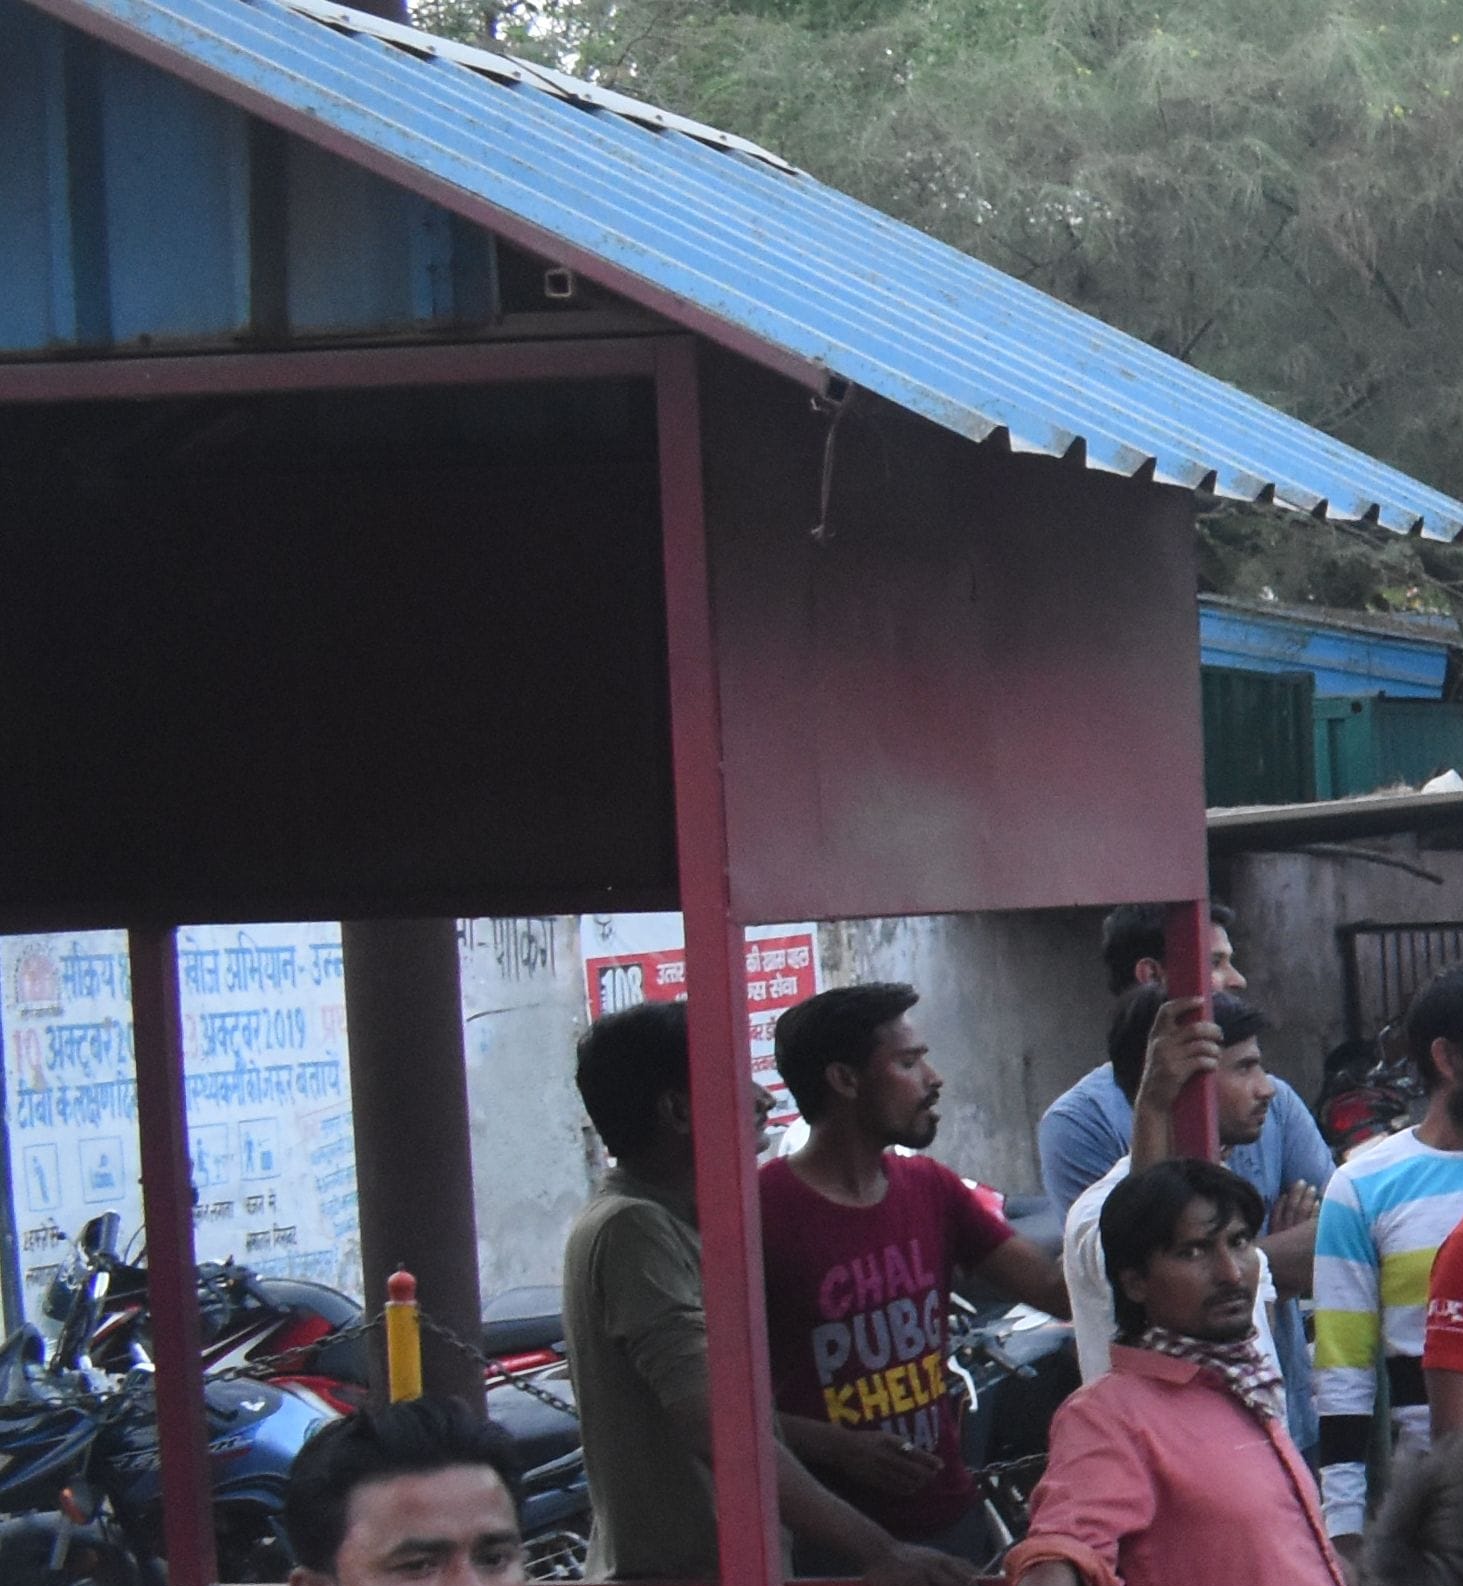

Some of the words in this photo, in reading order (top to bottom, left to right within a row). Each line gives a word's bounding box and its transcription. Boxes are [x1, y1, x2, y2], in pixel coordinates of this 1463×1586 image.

[600, 964, 645, 1013] 108
[820, 1239, 936, 1319] CHAL
[812, 1289, 941, 1386] PUBG
